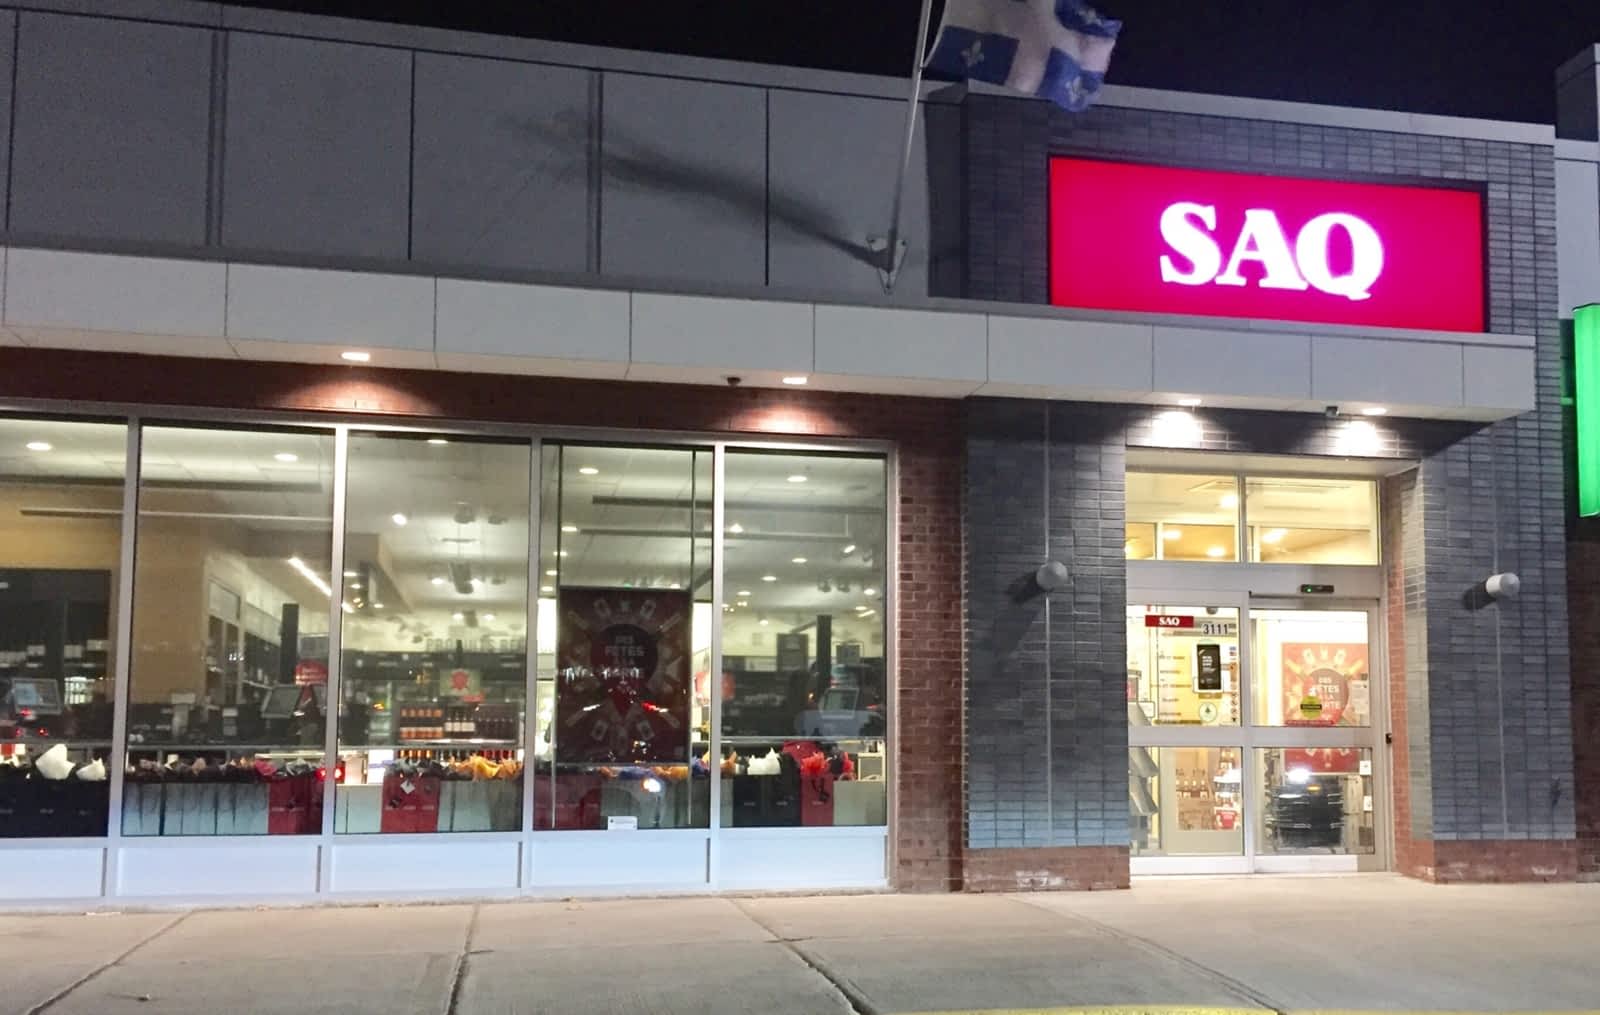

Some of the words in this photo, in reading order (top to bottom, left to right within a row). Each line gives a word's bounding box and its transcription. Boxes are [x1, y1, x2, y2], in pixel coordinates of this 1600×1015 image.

[1159, 201, 1385, 301] SAQ
[1158, 616, 1181, 627] SAQ
[1203, 623, 1229, 635] 3111
